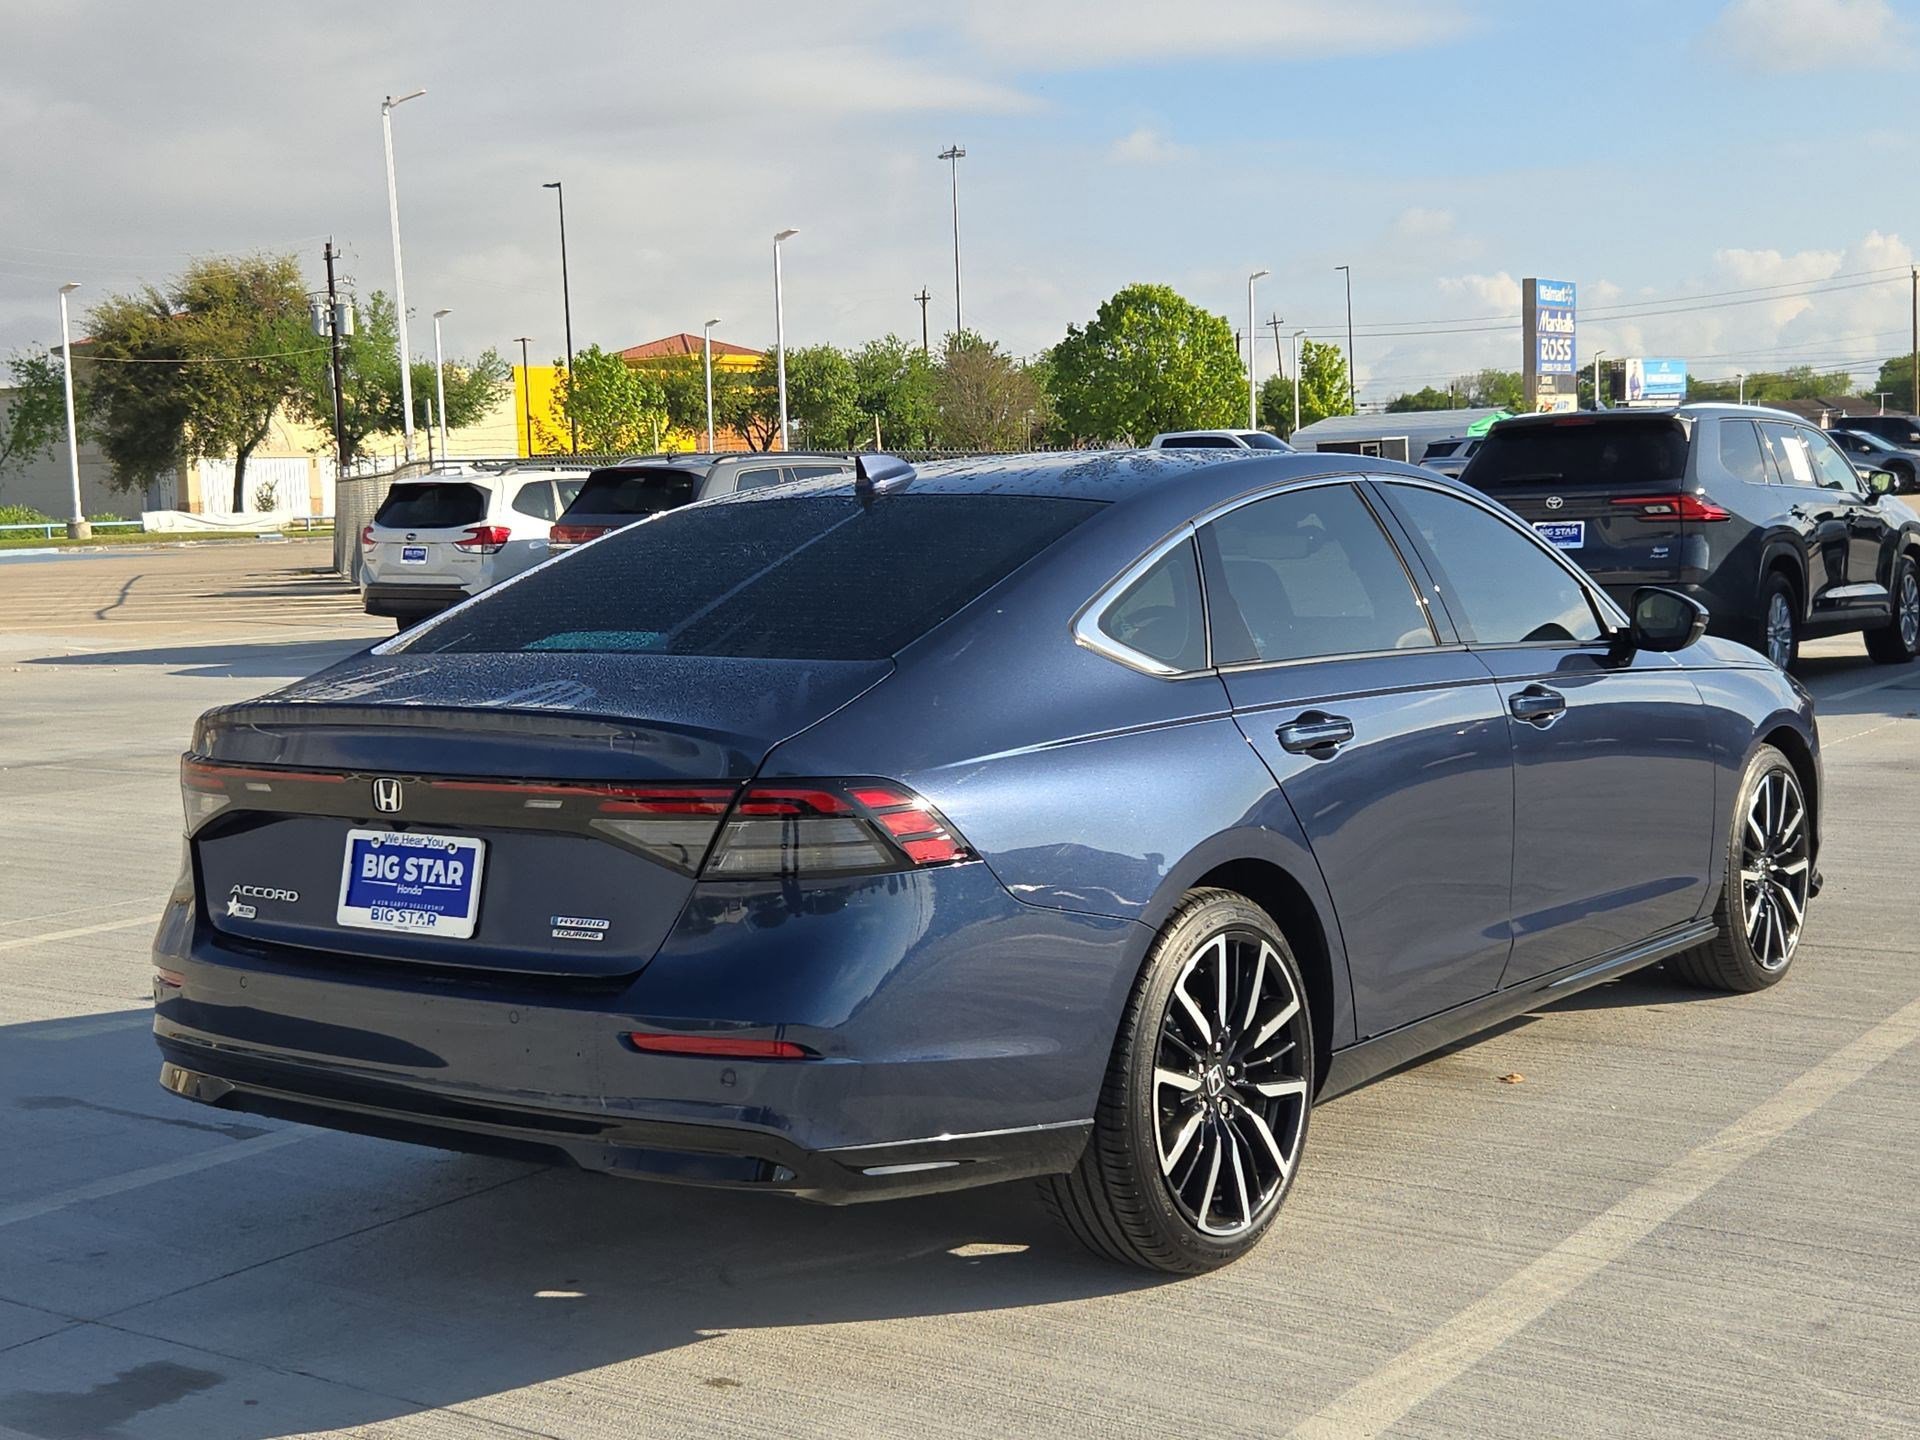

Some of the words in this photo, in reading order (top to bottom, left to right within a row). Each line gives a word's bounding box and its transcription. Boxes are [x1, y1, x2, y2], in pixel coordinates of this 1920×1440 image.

[1540, 285, 1565, 302] Walmart
[1538, 310, 1574, 333] Marshalls
[1541, 338, 1571, 361] ROSS
[1555, 527, 1578, 536] STAR
[384, 833, 400, 844] We
[401, 835, 425, 847] Hear
[426, 837, 444, 848] You
[362, 853, 400, 880] BIG
[403, 857, 464, 886] STAR
[230, 884, 299, 902] ACCORD
[396, 884, 423, 895] Honda
[409, 903, 445, 911] DEALERSHIP
[371, 907, 394, 921] BIG
[398, 911, 437, 926] STAR
[559, 918, 605, 927] HYBRID
[556, 930, 599, 938] TOURING
